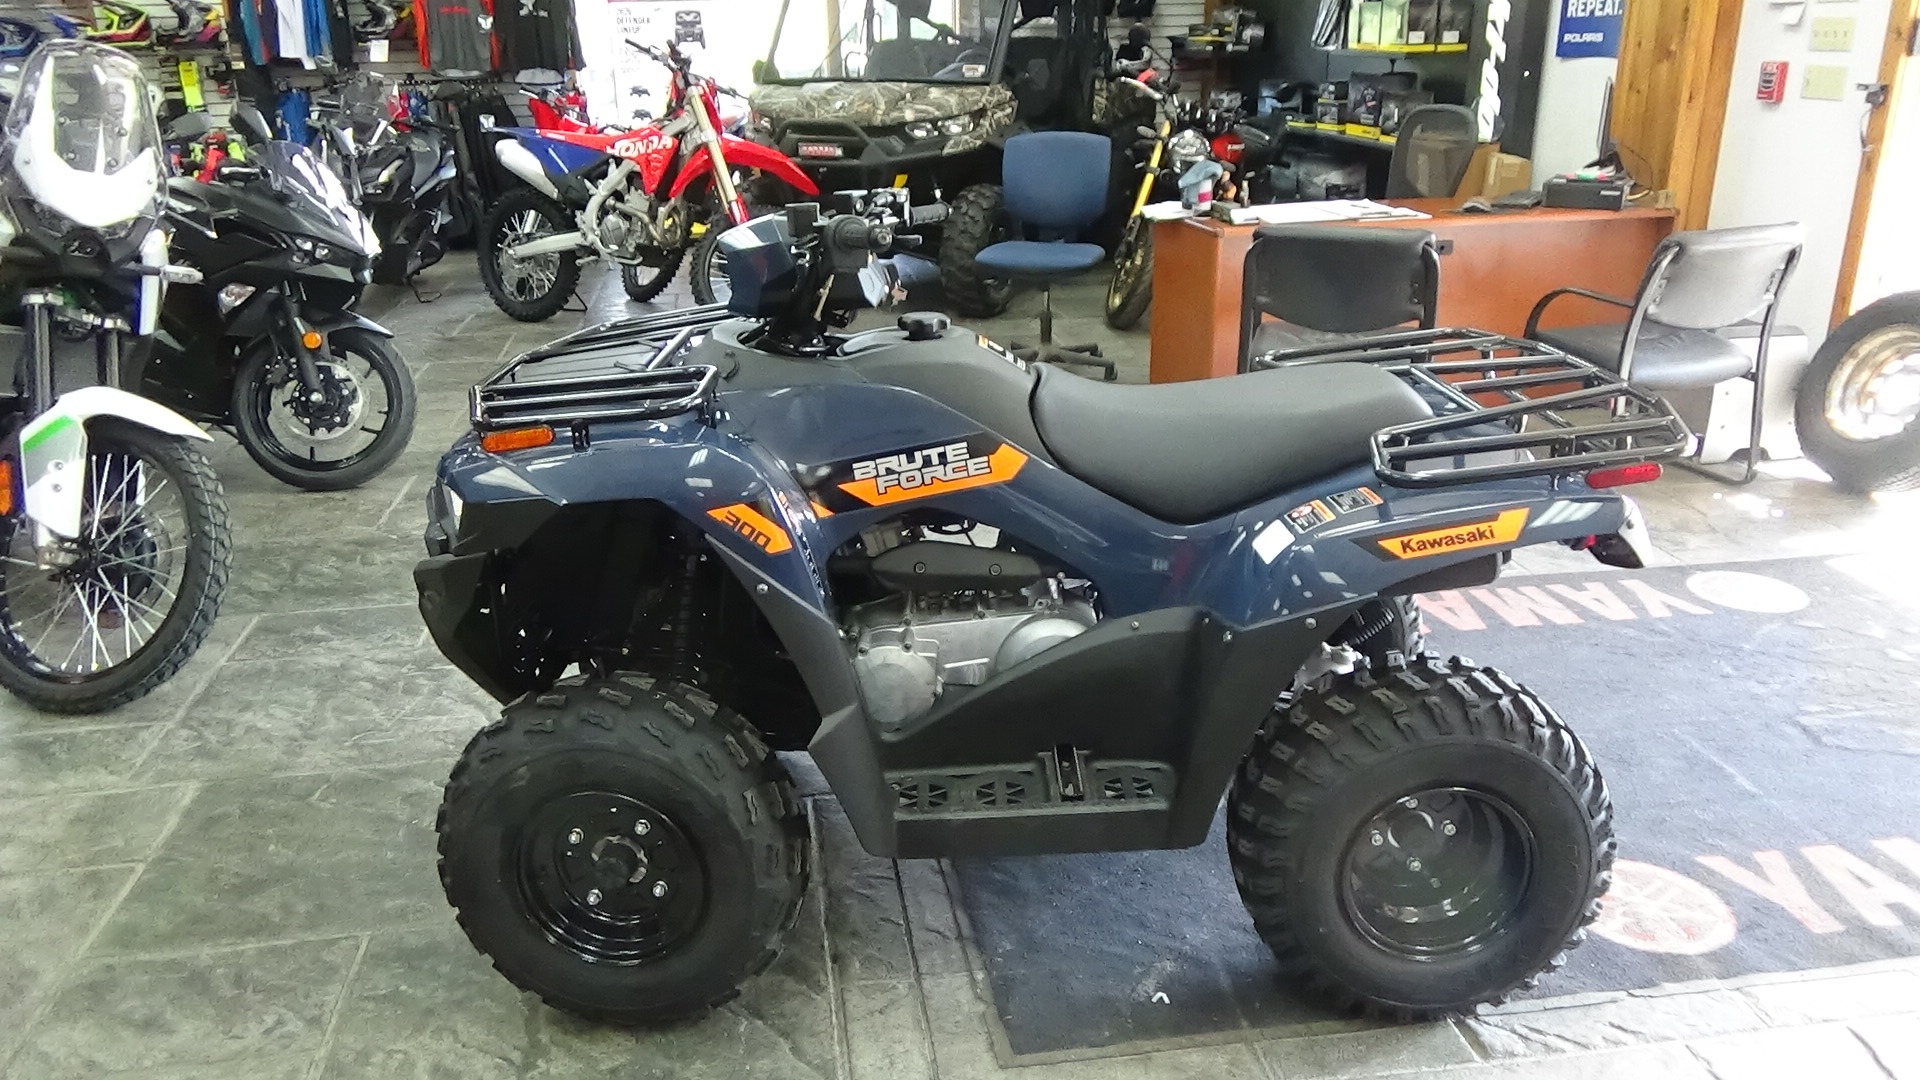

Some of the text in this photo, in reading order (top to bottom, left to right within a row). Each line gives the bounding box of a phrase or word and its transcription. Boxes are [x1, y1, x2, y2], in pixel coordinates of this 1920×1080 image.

[1566, 0, 1623, 18] REPEAT.
[1563, 32, 1604, 43] POLARIS
[606, 135, 674, 158] HONDA
[852, 441, 970, 482] BRUTE
[876, 455, 991, 496] FORCE
[721, 509, 772, 552] 300
[1400, 524, 1496, 555] Kawasaki
[1414, 579, 1713, 635] YAMA
